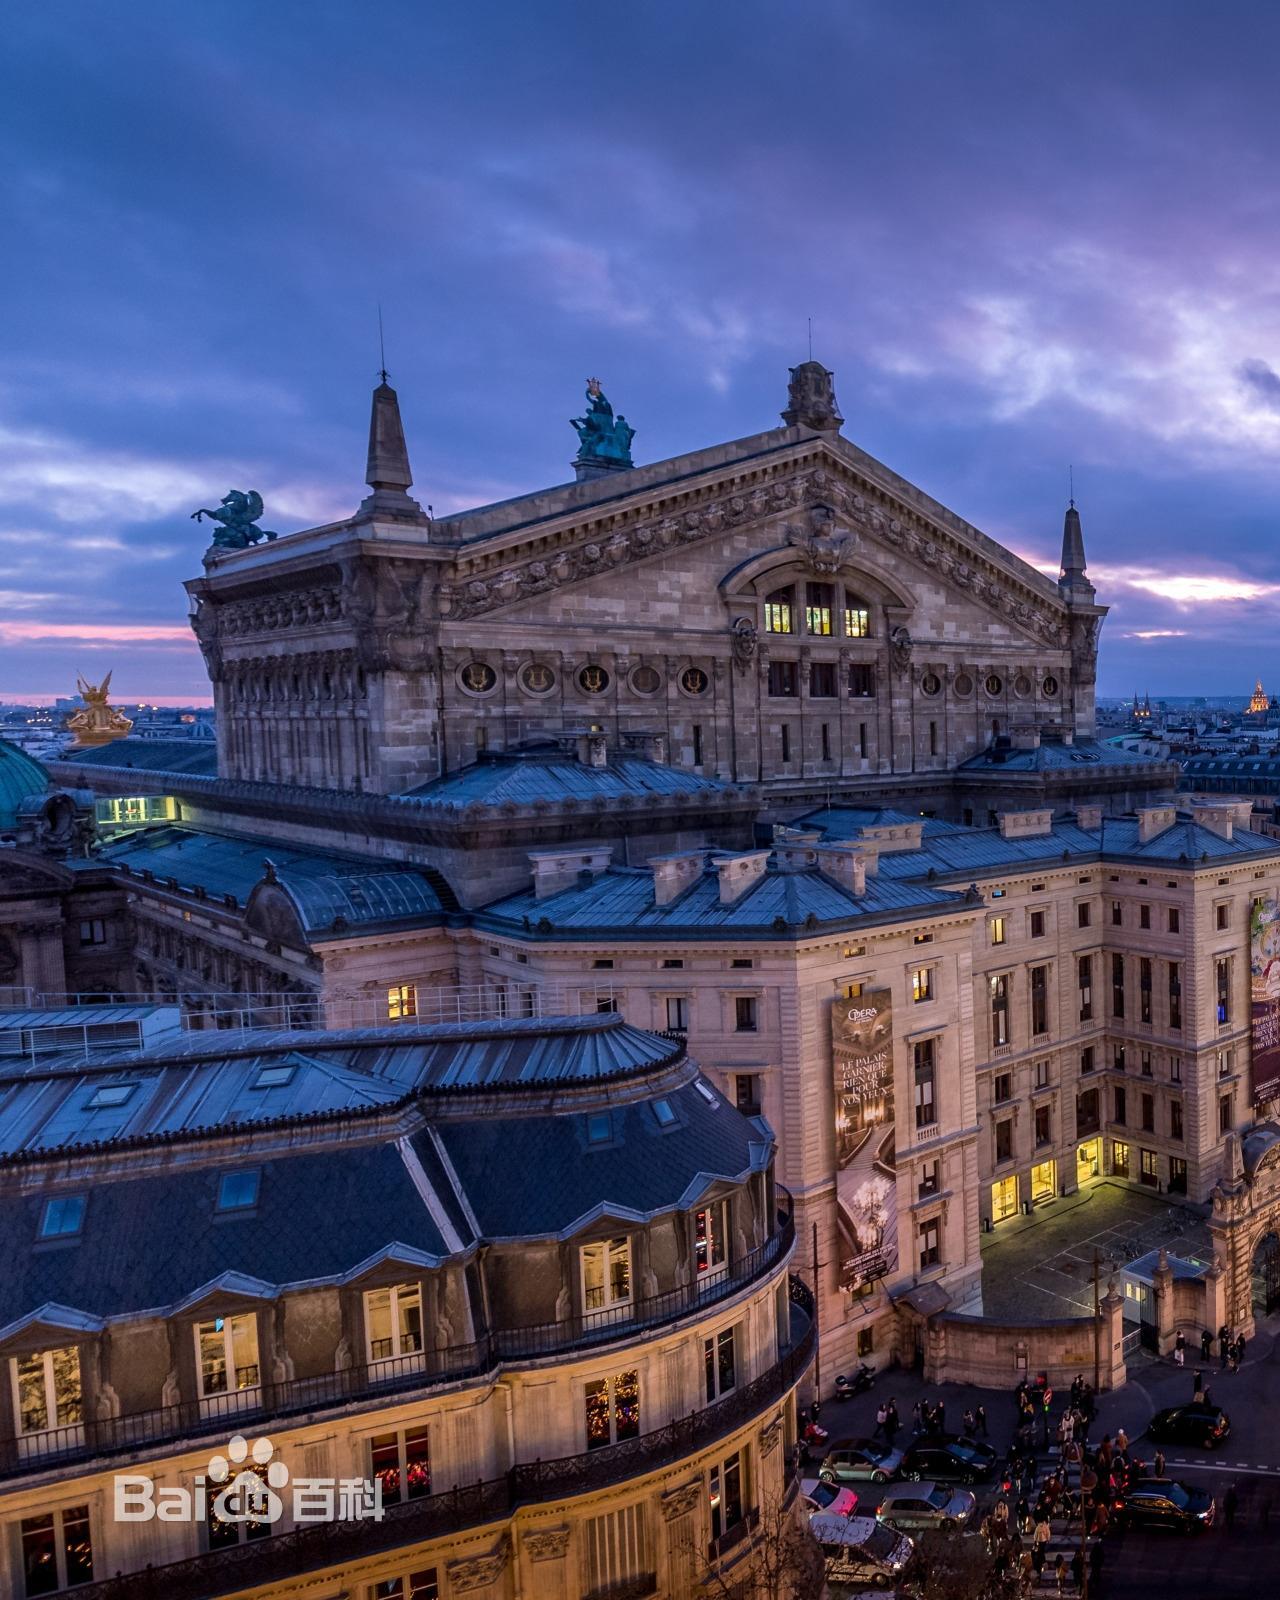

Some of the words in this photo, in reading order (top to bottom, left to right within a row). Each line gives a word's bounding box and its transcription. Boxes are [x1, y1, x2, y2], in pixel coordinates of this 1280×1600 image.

[856, 1052, 887, 1068] PALAIS
[843, 1076, 865, 1088] RIEN
[852, 1079, 879, 1095] POUR
